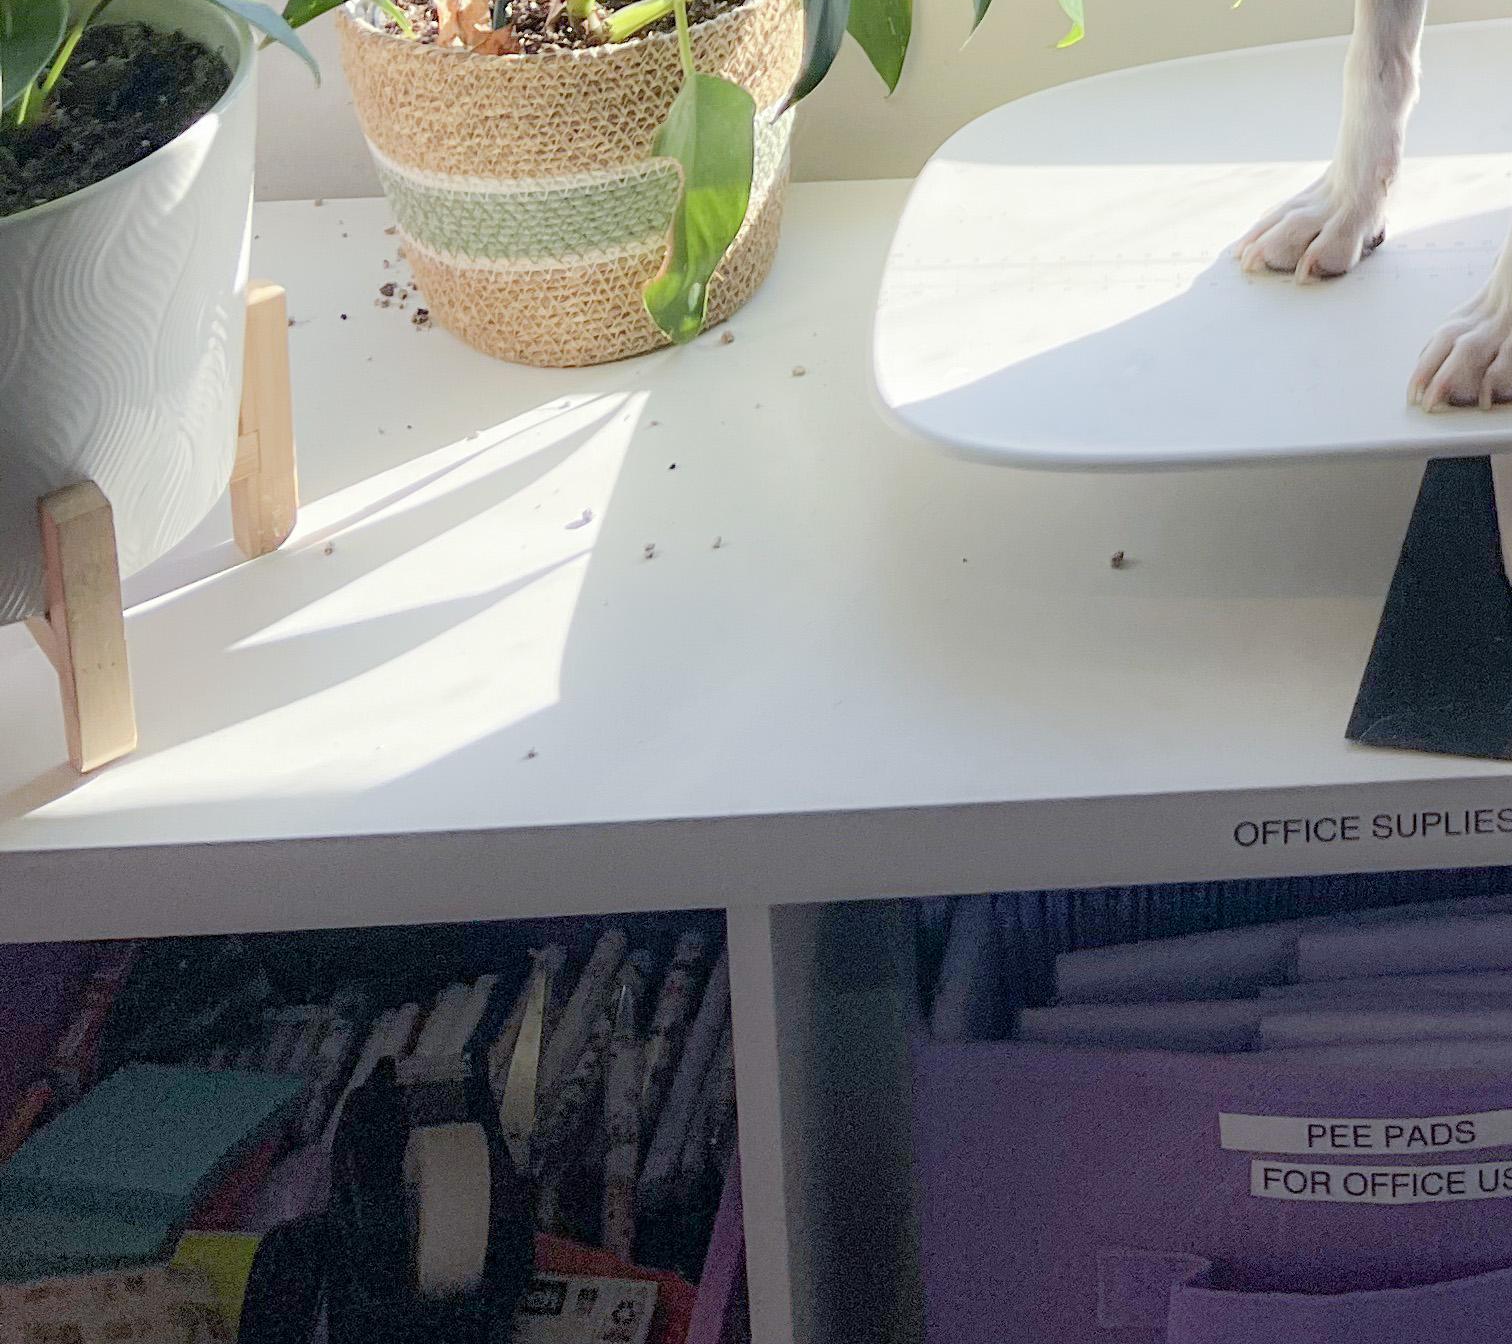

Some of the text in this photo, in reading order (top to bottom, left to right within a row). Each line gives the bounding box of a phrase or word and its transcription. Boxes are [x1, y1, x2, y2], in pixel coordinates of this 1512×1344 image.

[1233, 815, 1361, 847] OFFICE
[1307, 1120, 1477, 1149] PEE PADS
[1263, 1167, 1331, 1195] FOR
[1343, 1170, 1466, 1198] OFFICE
